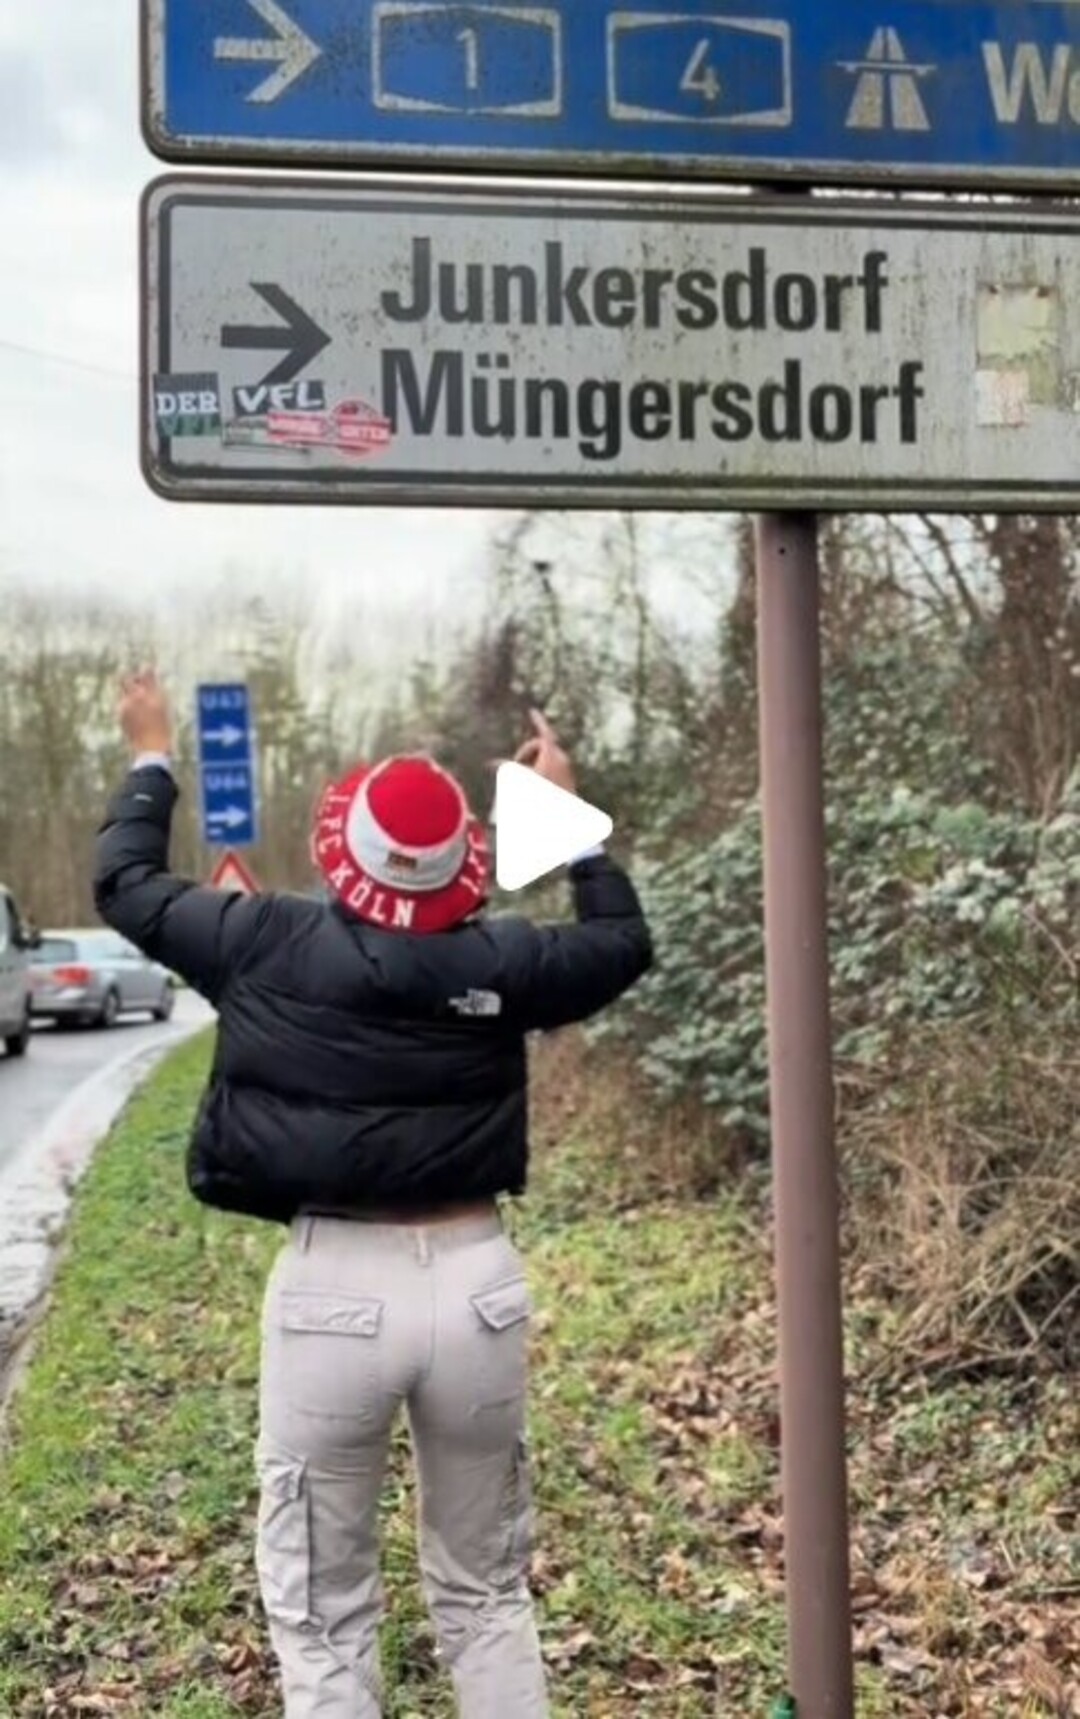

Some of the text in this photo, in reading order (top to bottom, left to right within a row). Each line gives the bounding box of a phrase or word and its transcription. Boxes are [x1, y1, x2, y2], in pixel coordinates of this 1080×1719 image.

[457, 28, 477, 89] 1
[680, 38, 720, 101] 4
[380, 236, 889, 332] Junkersdorf
[156, 390, 219, 415] DER
[380, 348, 925, 461] Müngersdorf
[329, 859, 416, 928] KÖLN
